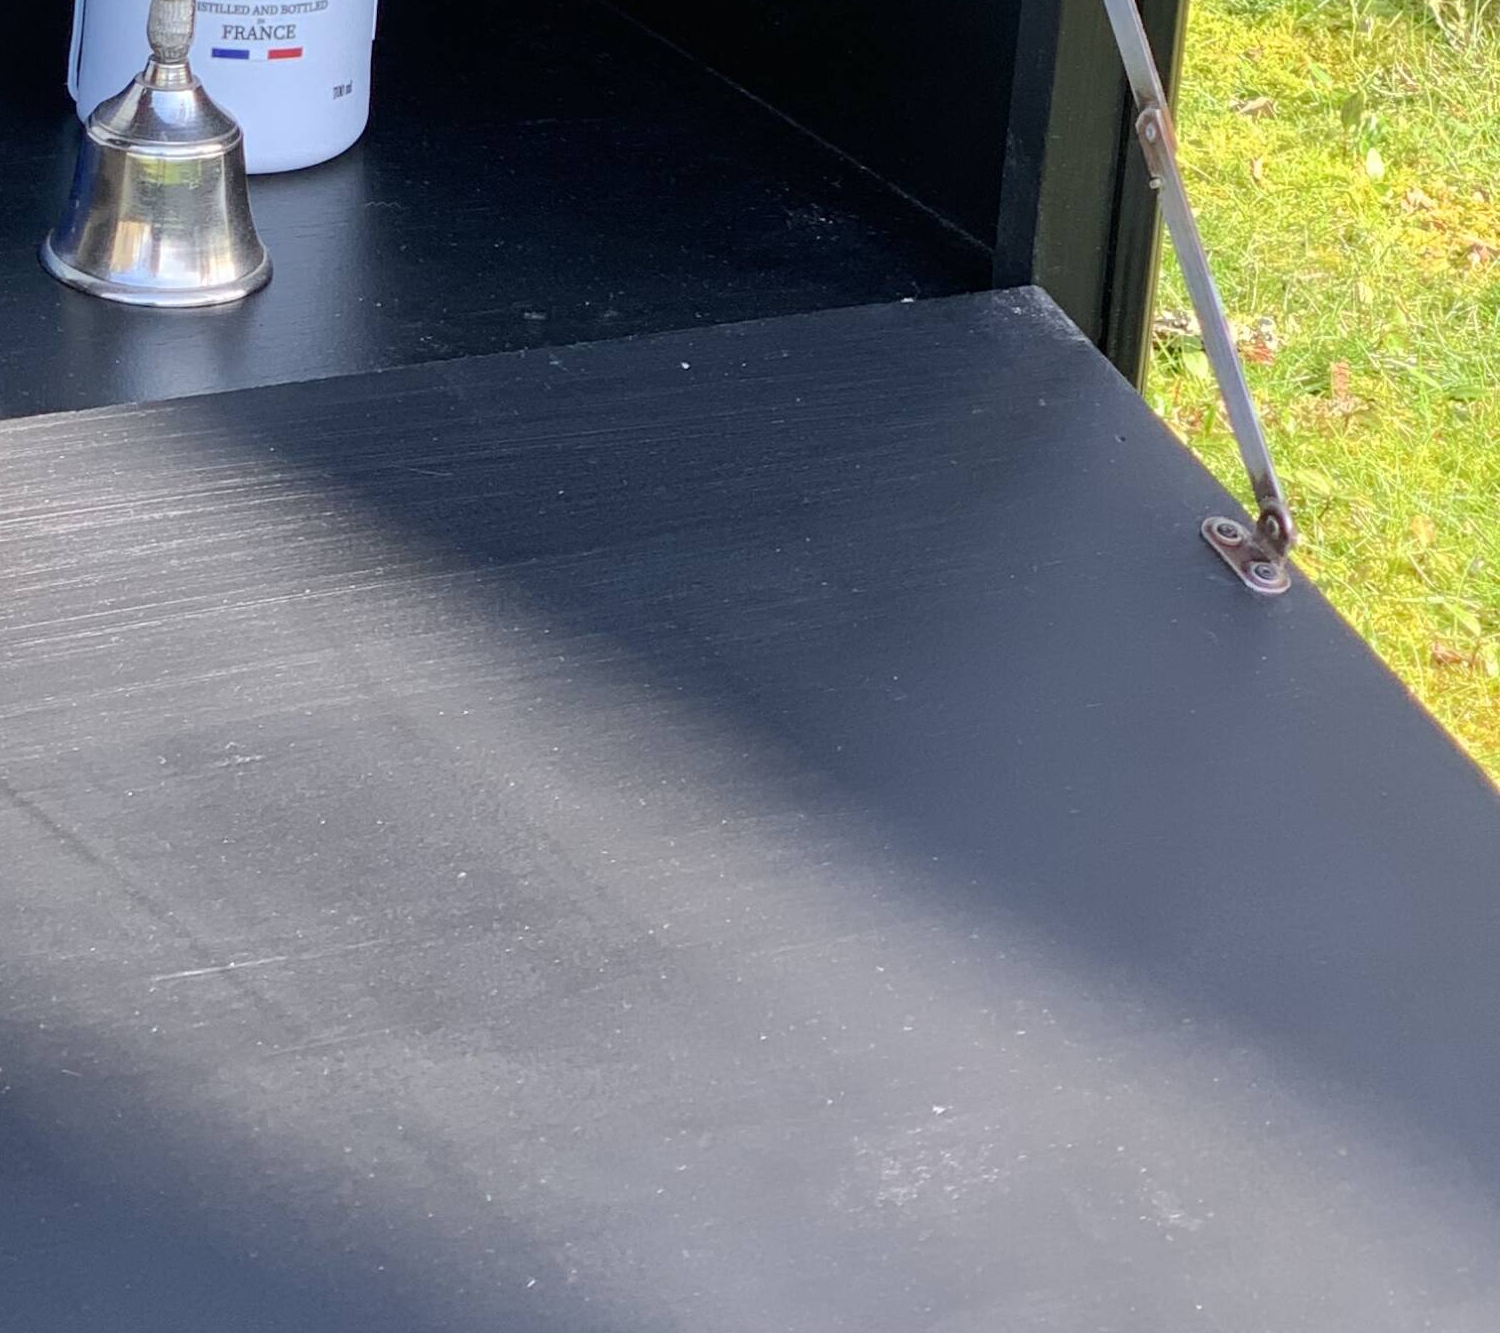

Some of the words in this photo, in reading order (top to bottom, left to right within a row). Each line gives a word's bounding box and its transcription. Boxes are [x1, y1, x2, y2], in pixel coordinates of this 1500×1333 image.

[197, 1, 250, 15] ISTILLED
[252, 5, 278, 16] AND
[281, 0, 328, 15] BOTTLED
[221, 24, 297, 41] FRANCE
